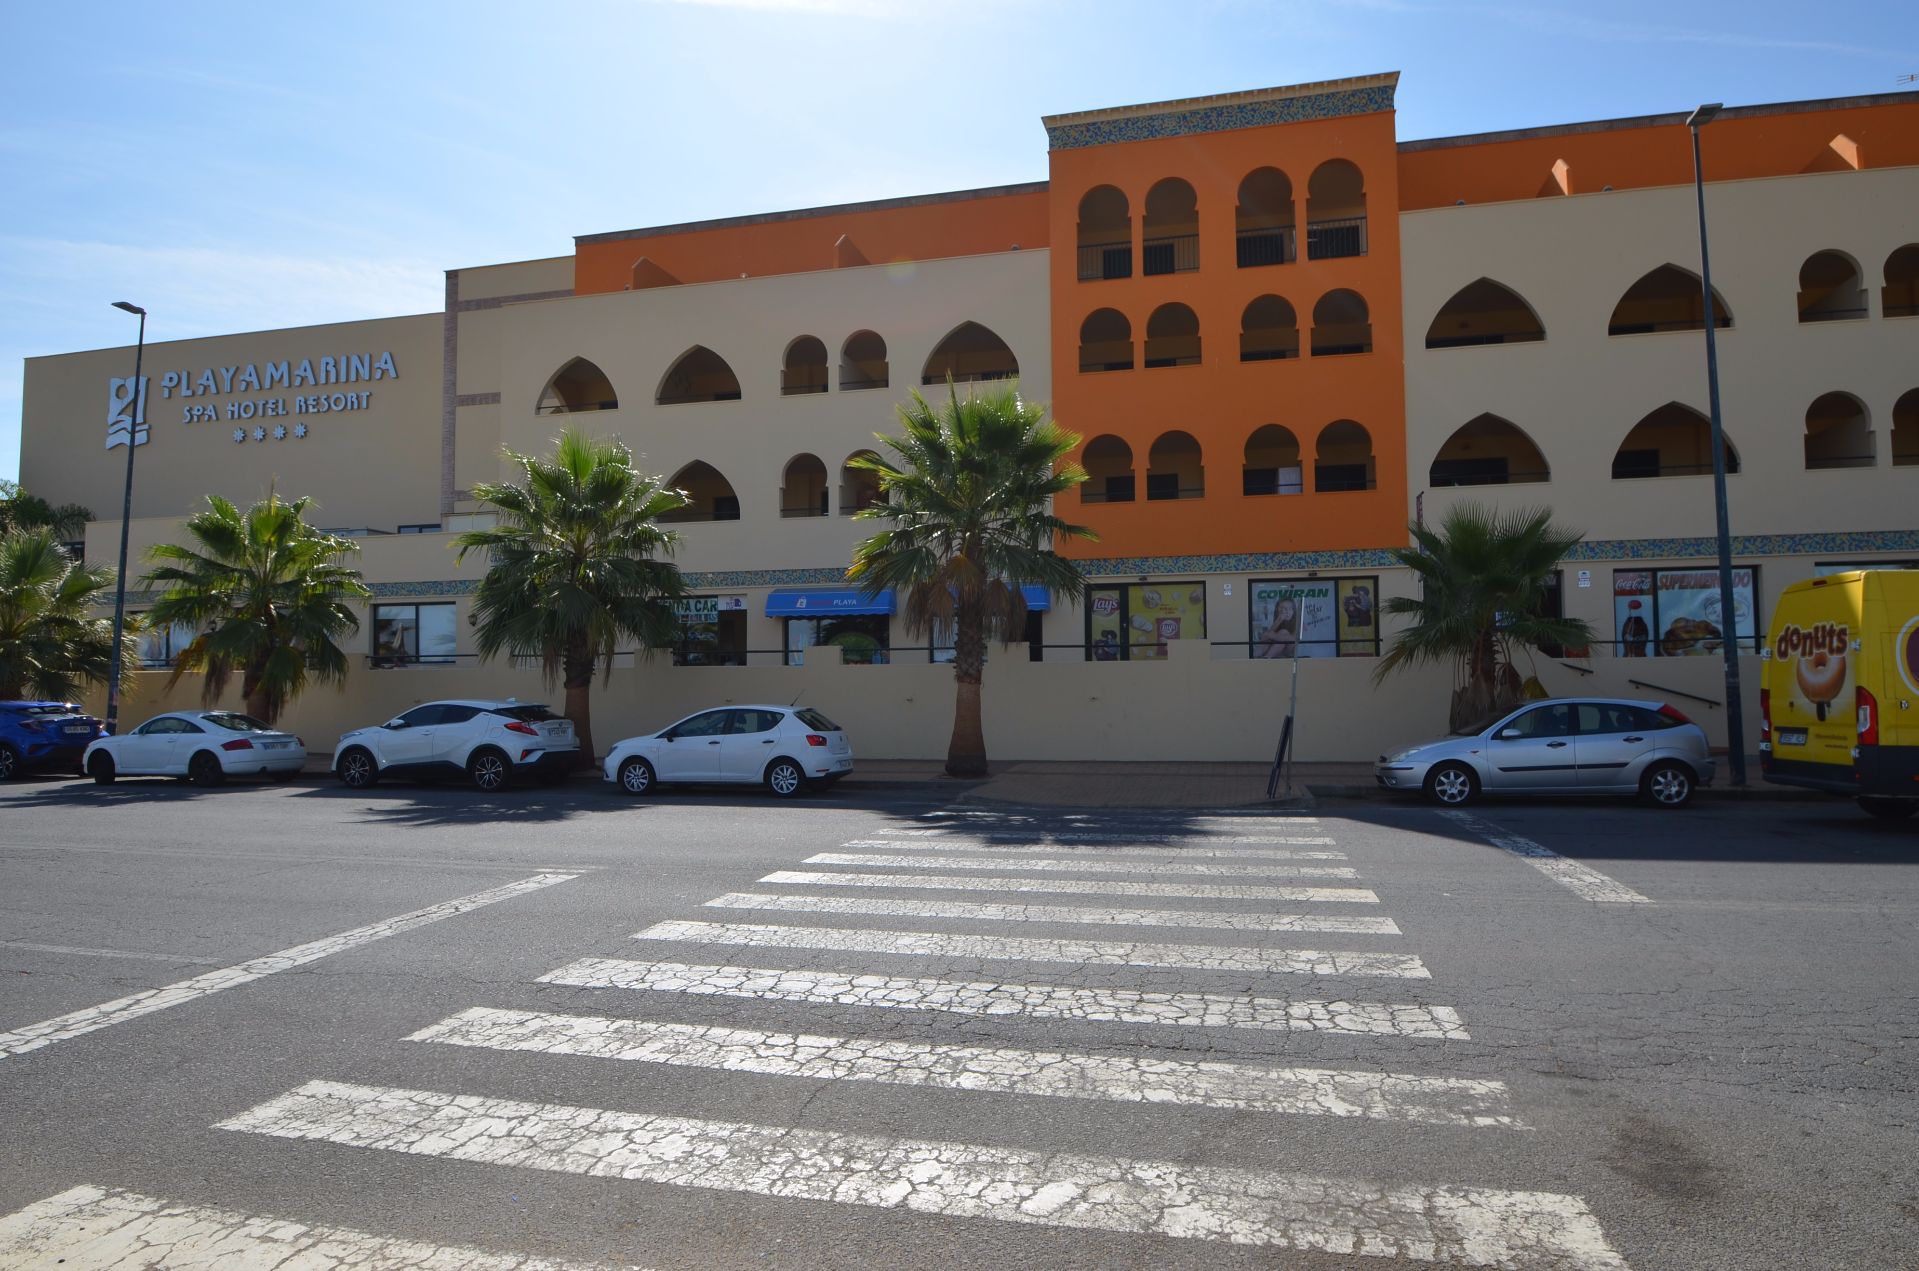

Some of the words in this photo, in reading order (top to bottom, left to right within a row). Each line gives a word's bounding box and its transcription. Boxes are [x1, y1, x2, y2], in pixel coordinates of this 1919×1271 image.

[160, 351, 399, 399] PLAYAMARINA
[182, 404, 218, 423] SPA
[226, 398, 288, 420] HOTEL
[295, 391, 372, 414] RESORT
[1658, 571, 1751, 590] SUPERMERDO
[694, 599, 717, 613] CAR
[1775, 622, 1849, 661] donuts
